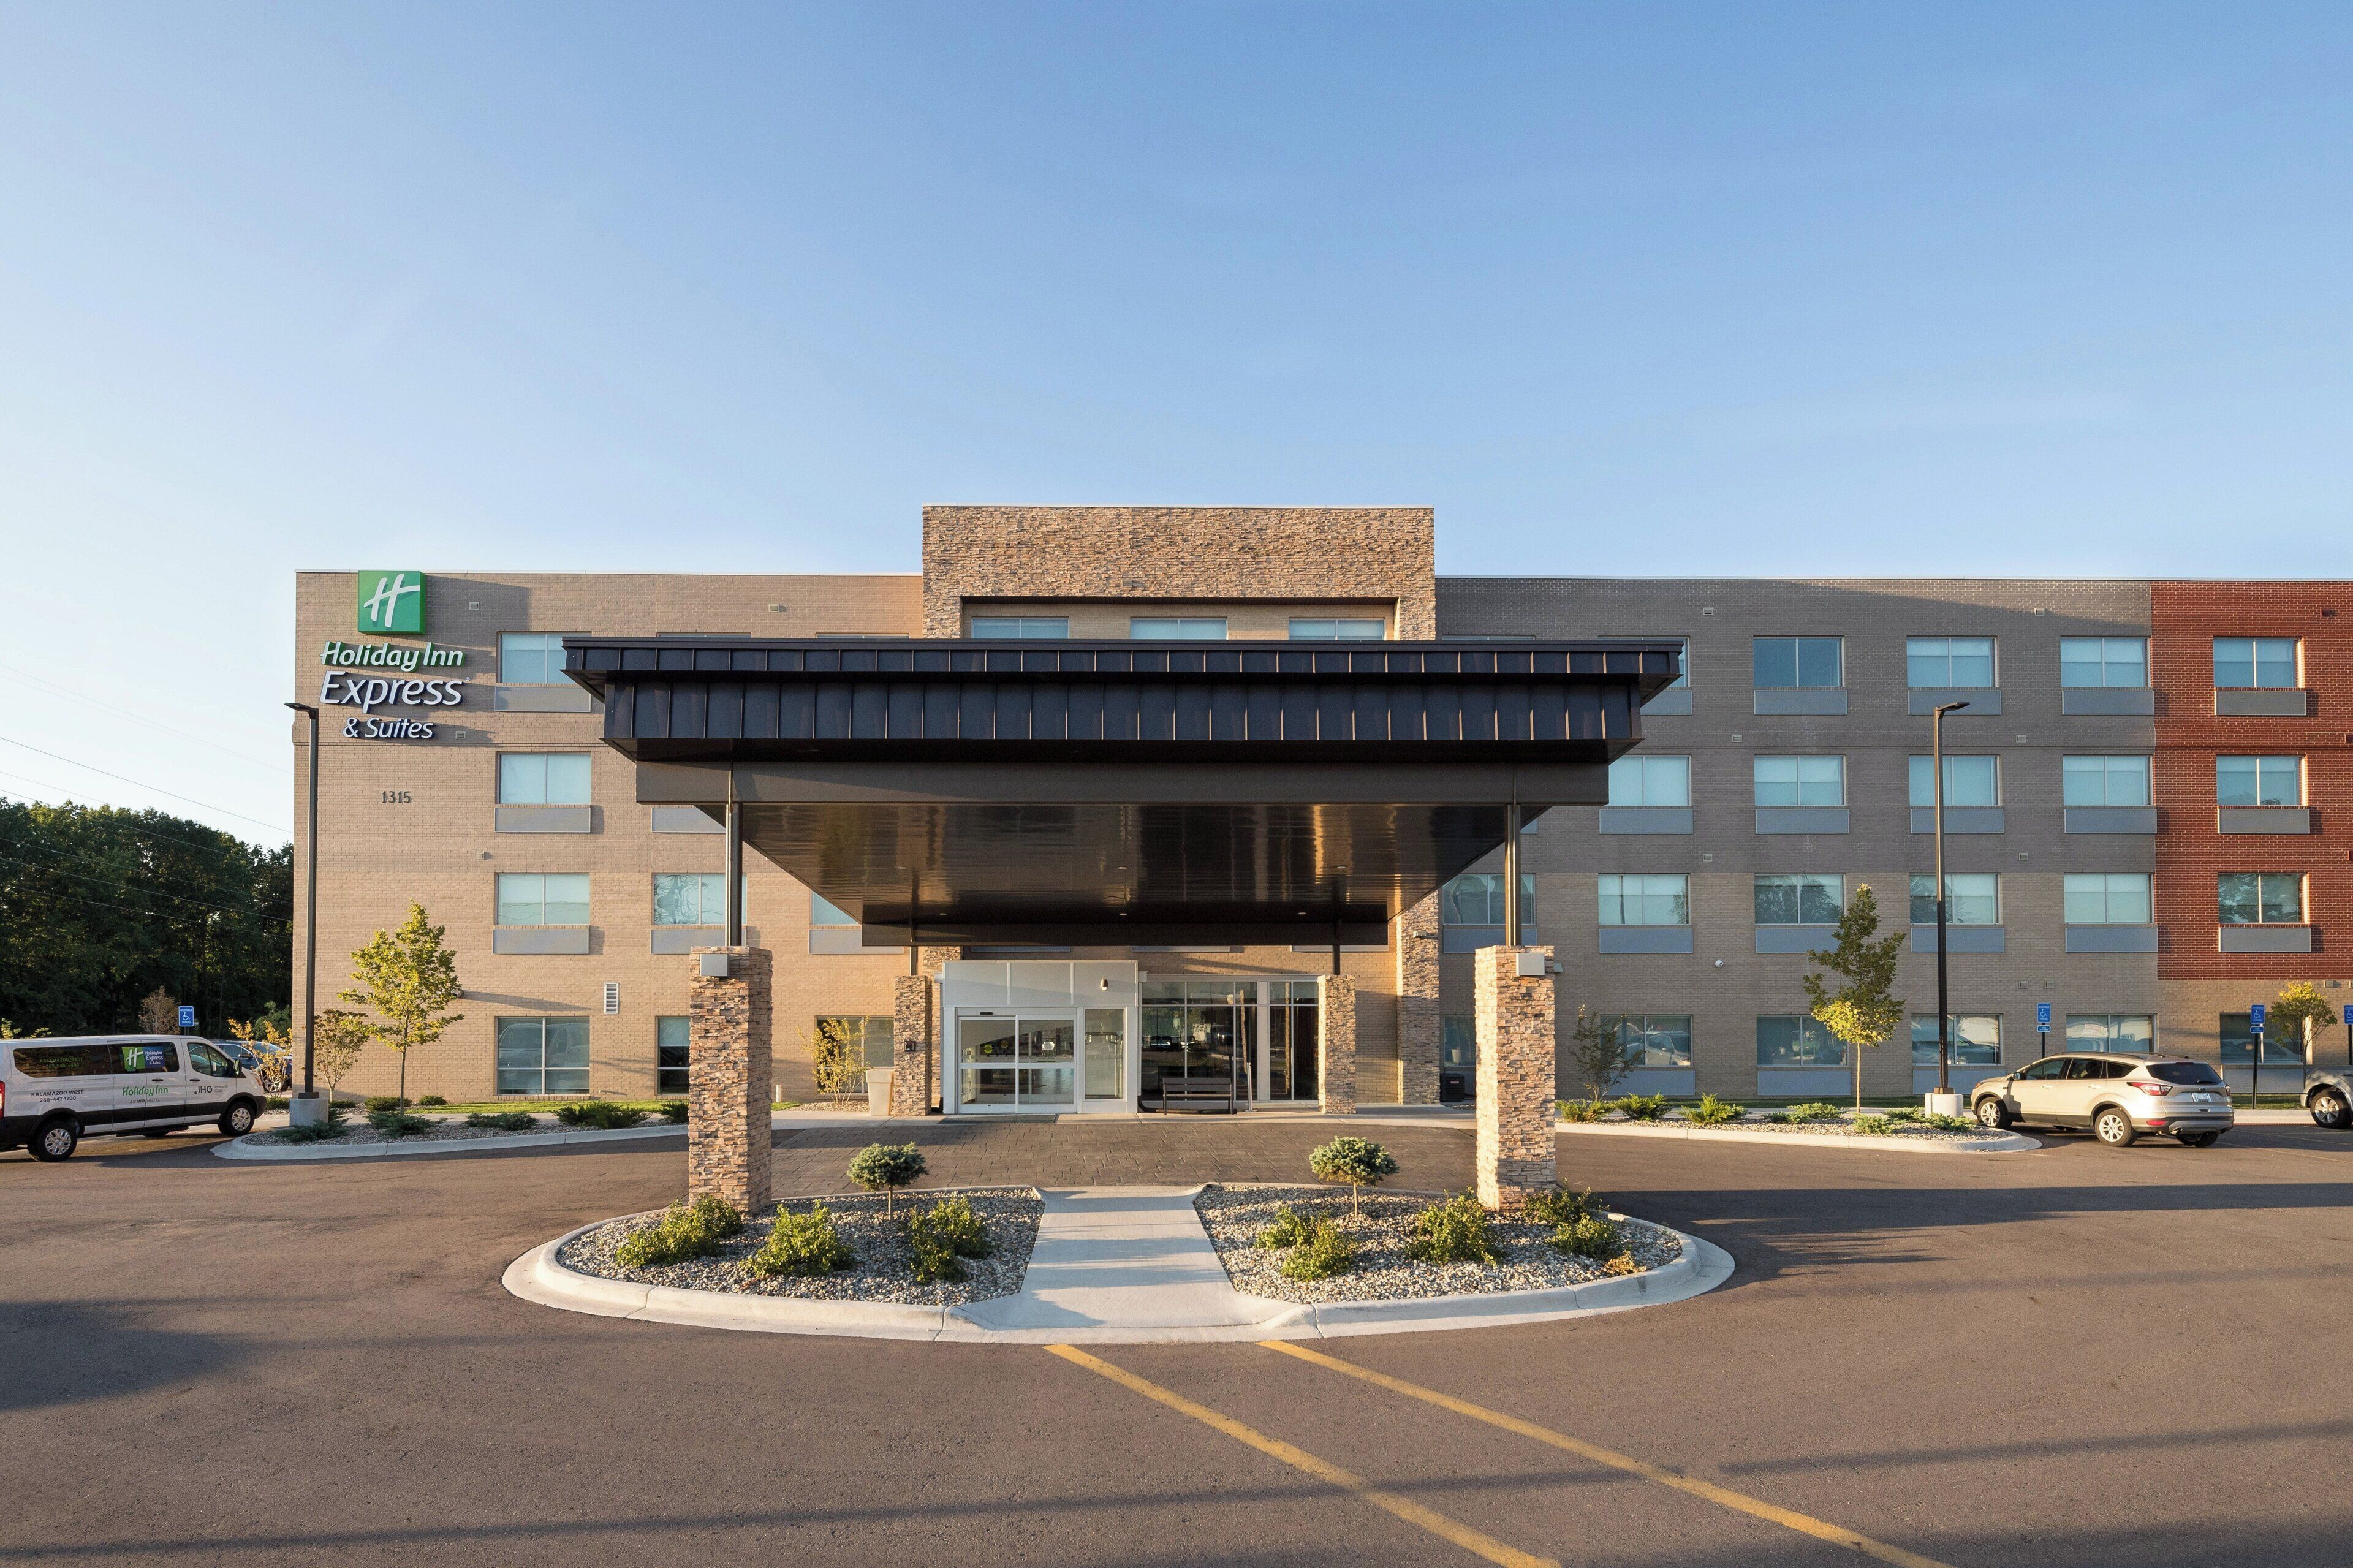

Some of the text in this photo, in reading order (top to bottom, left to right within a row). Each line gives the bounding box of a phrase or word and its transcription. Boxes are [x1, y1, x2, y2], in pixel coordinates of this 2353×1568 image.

[320, 641, 464, 672] Holiday Inn
[320, 670, 464, 714] Express
[343, 717, 434, 738] & Suites
[382, 791, 411, 803] 1315
[122, 1085, 169, 1097] Holiday Inn
